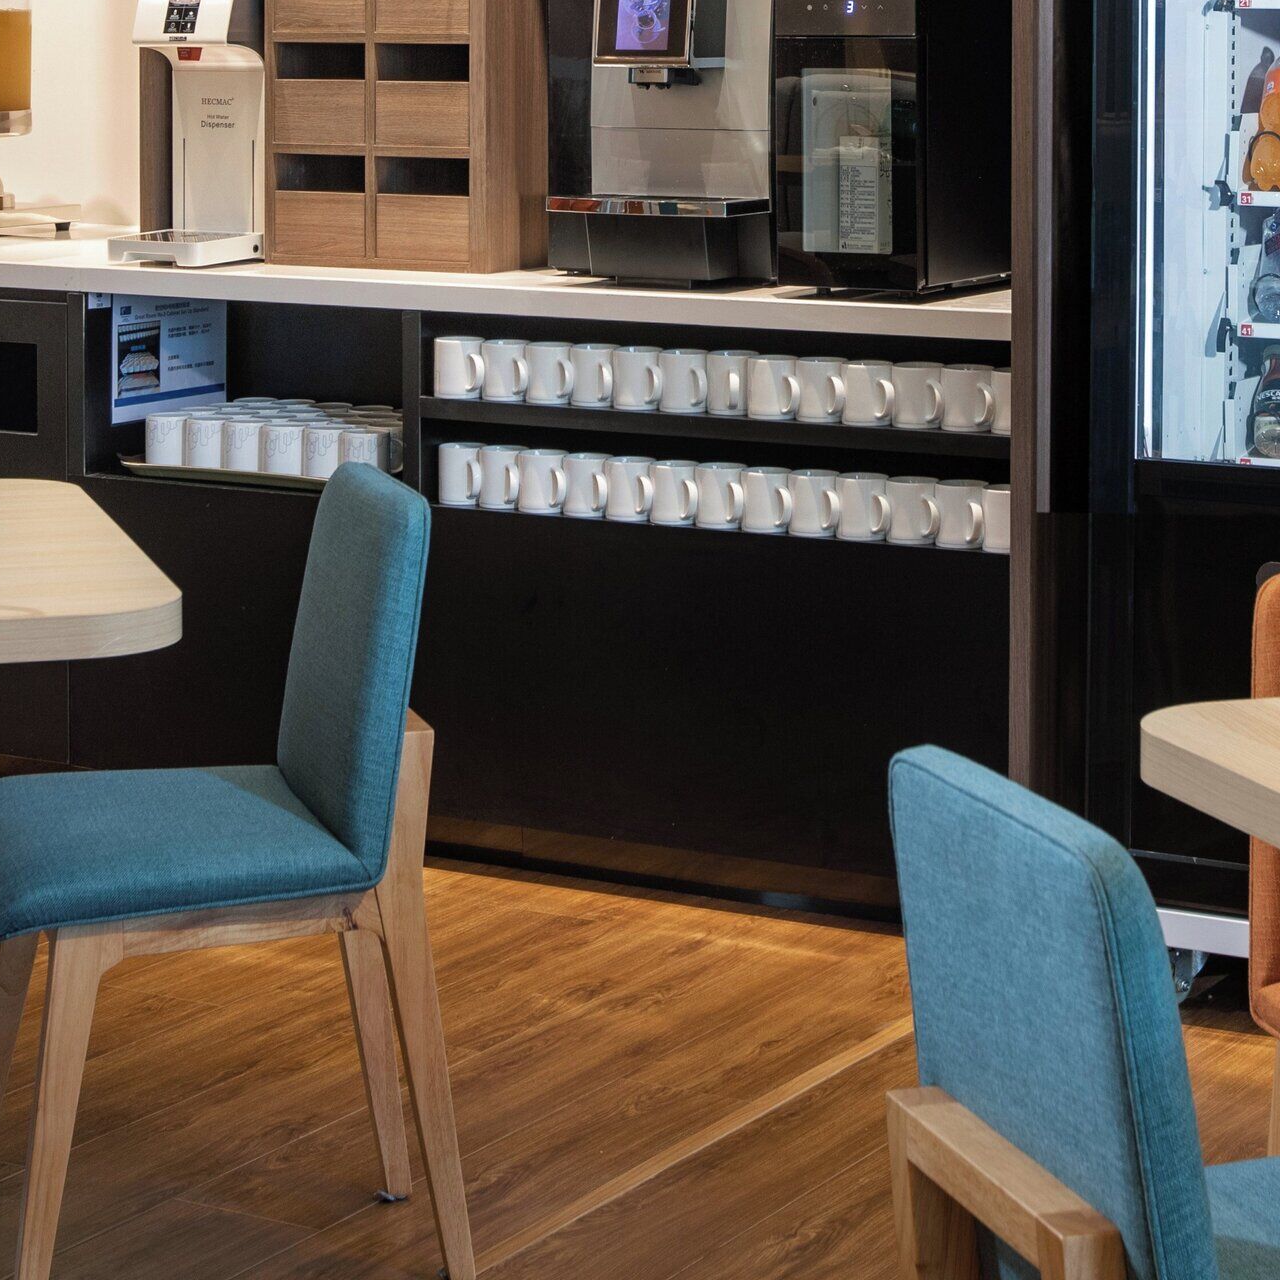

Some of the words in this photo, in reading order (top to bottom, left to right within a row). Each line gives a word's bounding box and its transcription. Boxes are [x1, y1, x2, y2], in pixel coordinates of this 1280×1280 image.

[846, 0, 853, 13] 3
[1240, 0, 1249, 7] 21
[201, 120, 235, 130] Dispenser
[1241, 327, 1251, 335] 41
